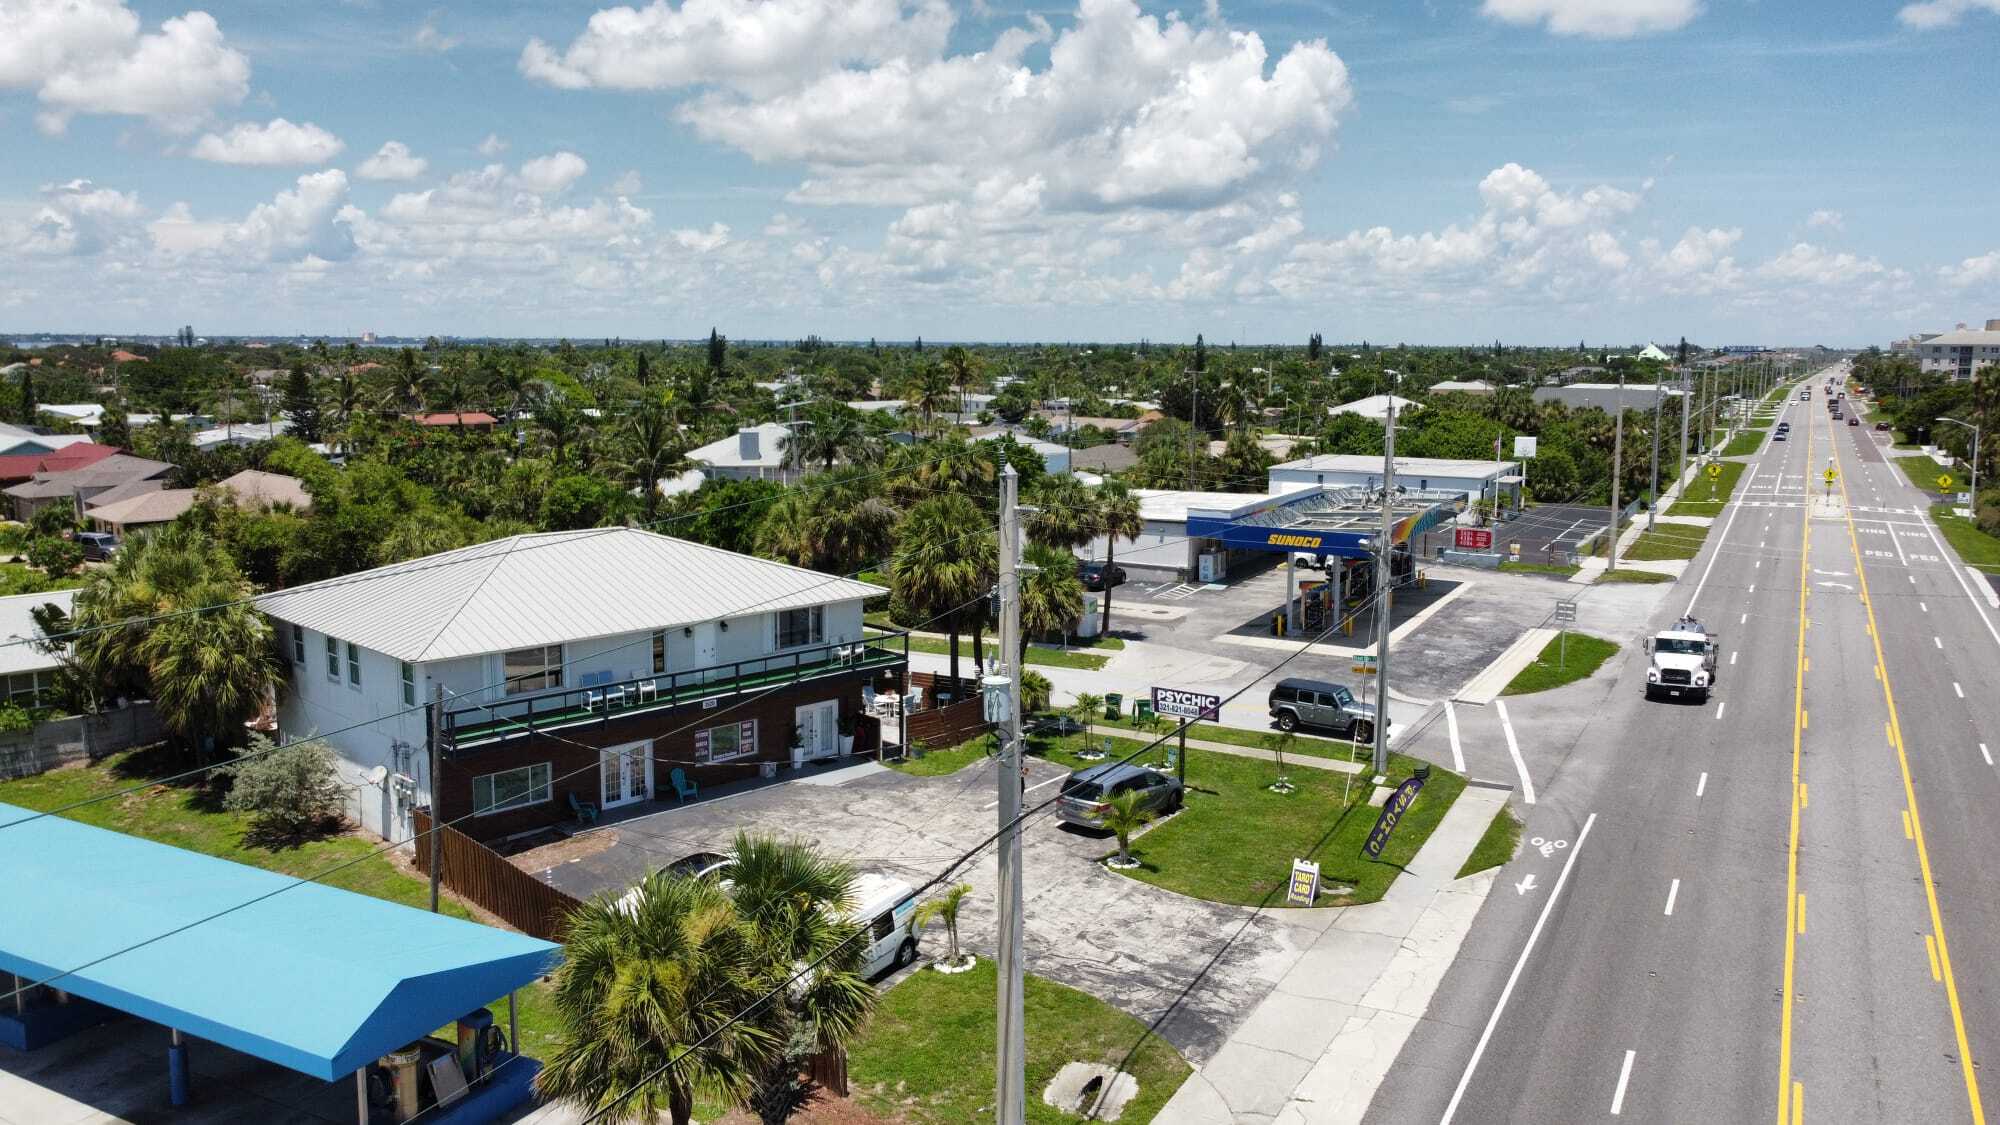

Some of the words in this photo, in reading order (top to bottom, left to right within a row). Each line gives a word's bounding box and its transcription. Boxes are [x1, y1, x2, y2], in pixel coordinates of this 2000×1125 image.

[1267, 534, 1322, 549] SUNOCO
[1157, 689, 1216, 709] PSYCHIC
[1294, 883, 1311, 895] CARD
